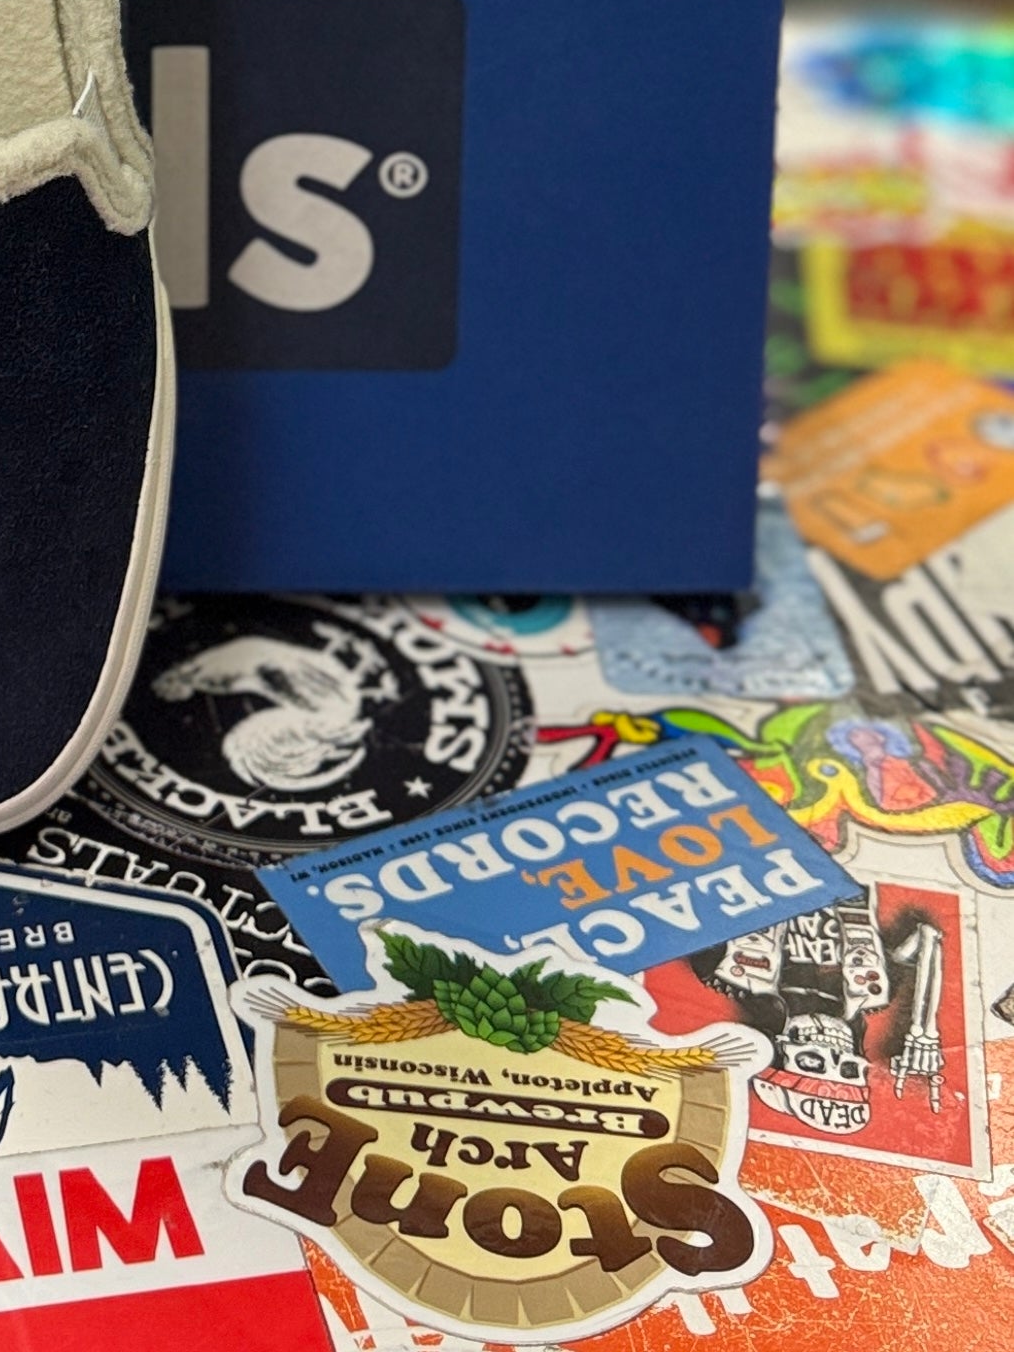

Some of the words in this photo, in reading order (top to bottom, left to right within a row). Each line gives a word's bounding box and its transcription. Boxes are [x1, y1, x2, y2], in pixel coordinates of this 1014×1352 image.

[307, 762, 736, 919] RECORDS.
[522, 805, 777, 910] LOVE,
[333, 1052, 492, 1088] Wisconsin
[501, 1066, 660, 1104] Appleton,
[348, 1082, 646, 1136] Brewpub
[801, 1098, 866, 1130] DEAD
[410, 1122, 590, 1182] Arch
